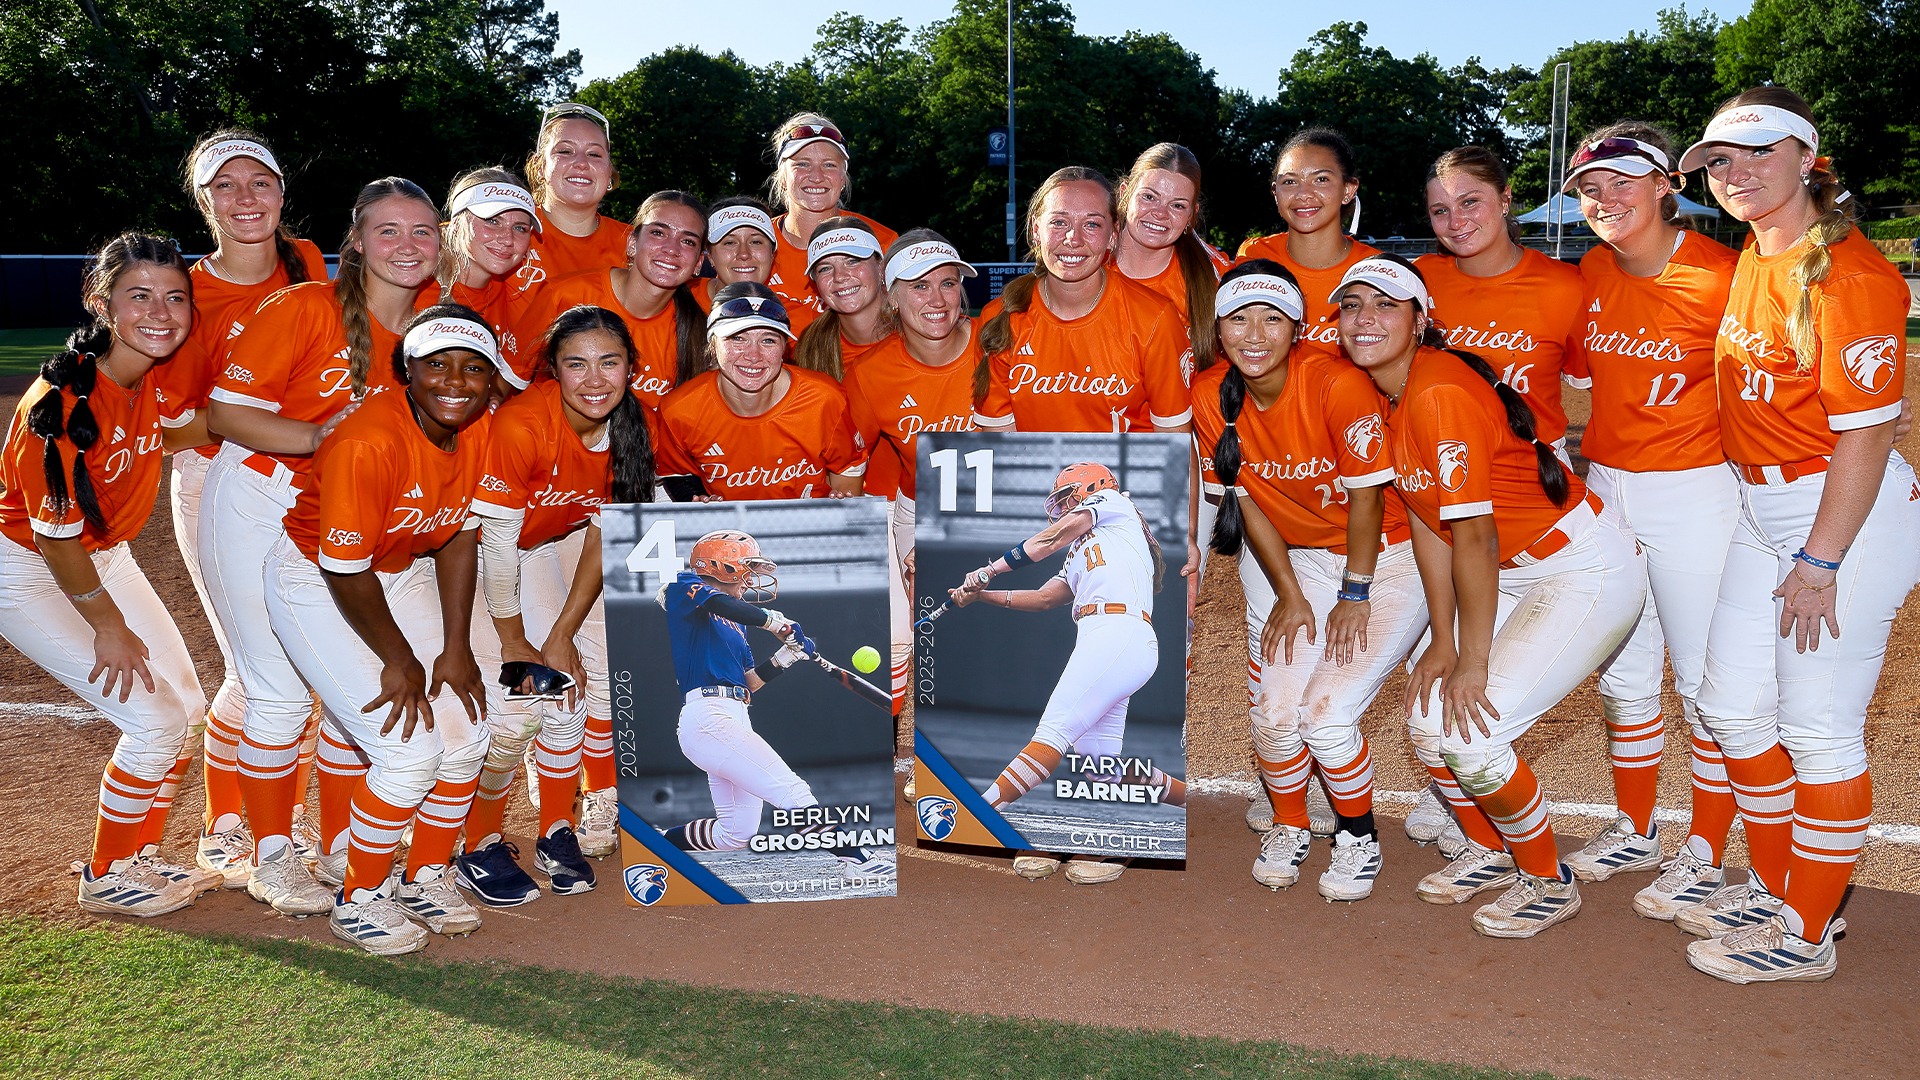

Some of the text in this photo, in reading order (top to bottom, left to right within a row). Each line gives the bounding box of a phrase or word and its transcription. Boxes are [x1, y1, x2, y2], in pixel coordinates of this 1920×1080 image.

[207, 143, 266, 162] Patriots
[719, 210, 766, 223] Patriots
[812, 233, 857, 256] Patriots
[1232, 280, 1289, 295] Patriots
[428, 322, 489, 344] Patriots
[1438, 320, 1539, 352] triots
[1009, 363, 1134, 396] Patriots
[1502, 362, 1535, 394] 16
[1644, 373, 1687, 407] 12
[897, 404, 978, 444] Patri
[700, 458, 823, 488] Patriots
[928, 449, 994, 513] 11
[387, 495, 471, 535] Patri
[625, 519, 685, 584] 4
[1083, 543, 1107, 572] 11
[614, 670, 638, 777] 2023-2026
[1066, 754, 1152, 777] TARYN
[1056, 779, 1165, 804] BARNEY
[773, 805, 870, 827] BERLYN
[750, 827, 895, 852] GROSSMAN
[1070, 831, 1161, 850] CATCHER
[770, 874, 890, 893] OUTFIELDER
